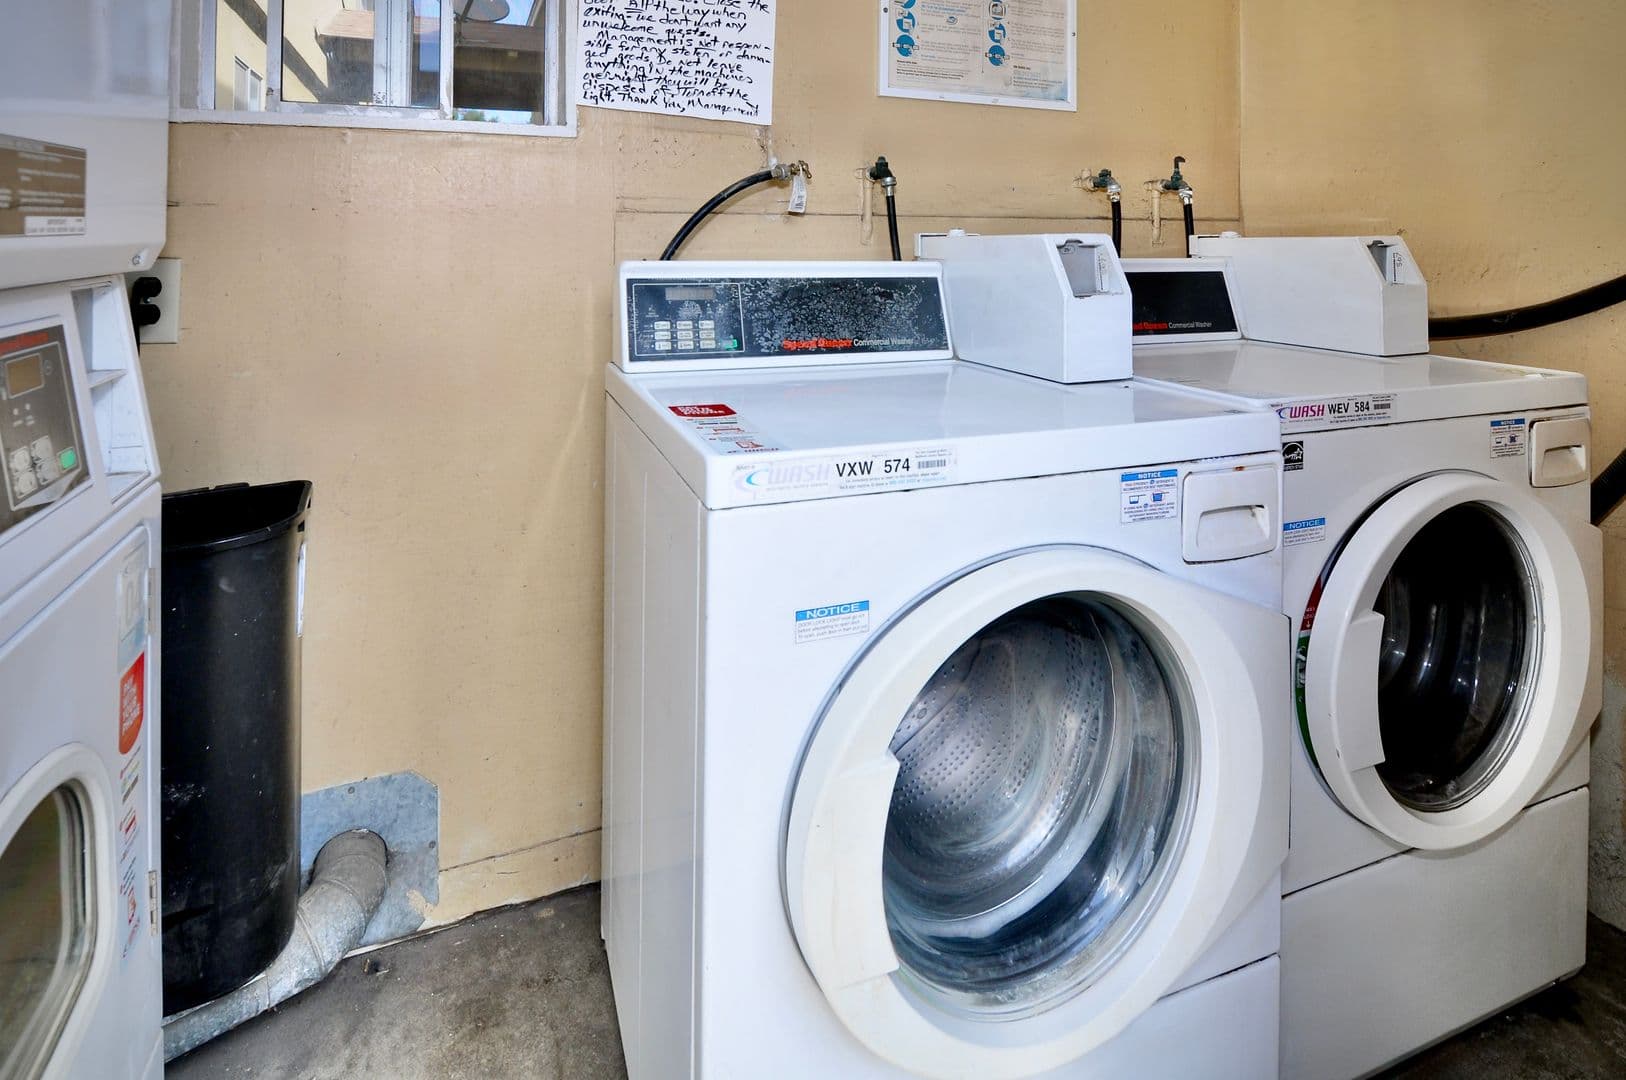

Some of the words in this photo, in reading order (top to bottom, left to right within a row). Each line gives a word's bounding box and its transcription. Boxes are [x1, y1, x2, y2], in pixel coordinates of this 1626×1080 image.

[712, 7, 747, 20] when
[725, 22, 747, 33] any
[672, 46, 710, 58] stolen
[586, 57, 646, 78] anything
[669, 66, 692, 78] the
[707, 59, 744, 73] leave
[684, 77, 709, 86] will
[715, 79, 728, 88] be
[853, 338, 890, 347] Commercial
[1289, 404, 1325, 419] WASH
[1327, 402, 1350, 416] WEV
[1354, 400, 1370, 413] 584
[836, 460, 874, 477] VXW
[883, 457, 910, 474] 574
[1138, 471, 1162, 480] NOTICE
[1289, 519, 1320, 529] NOTICE
[806, 603, 860, 619] NOTICE
